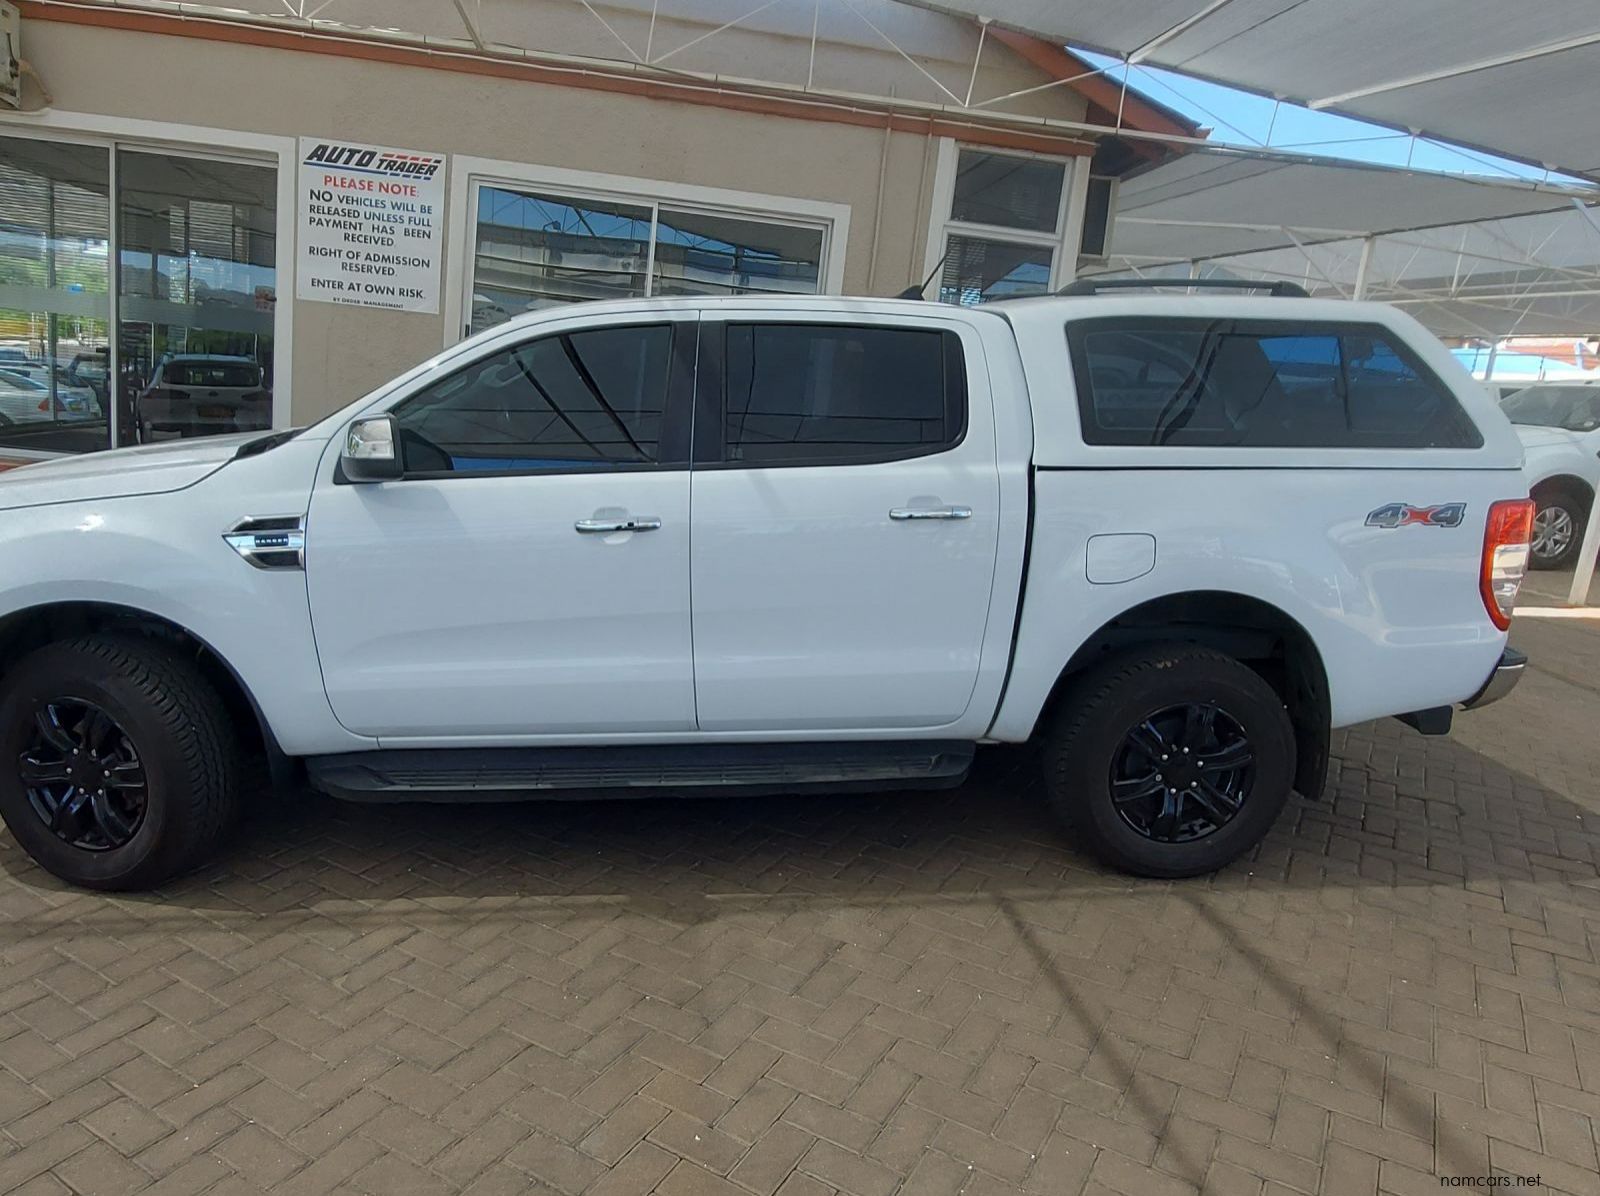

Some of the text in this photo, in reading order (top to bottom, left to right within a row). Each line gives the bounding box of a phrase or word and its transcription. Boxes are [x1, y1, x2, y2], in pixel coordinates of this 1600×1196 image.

[306, 144, 438, 176] AUTO TRADER
[324, 175, 374, 191] PLEASE
[309, 189, 432, 214] NO VEHICLES WILL BE
[309, 205, 432, 227] RELEASED UNLESS FULL
[309, 217, 431, 239] PAYMENT HAS BEEN
[308, 246, 430, 268] RIGHT OF ADMISSION
[342, 262, 398, 277] RESERVED.
[311, 278, 426, 299] ENTER AT OWN RISK.
[363, 300, 404, 309] MANAGEMENT
